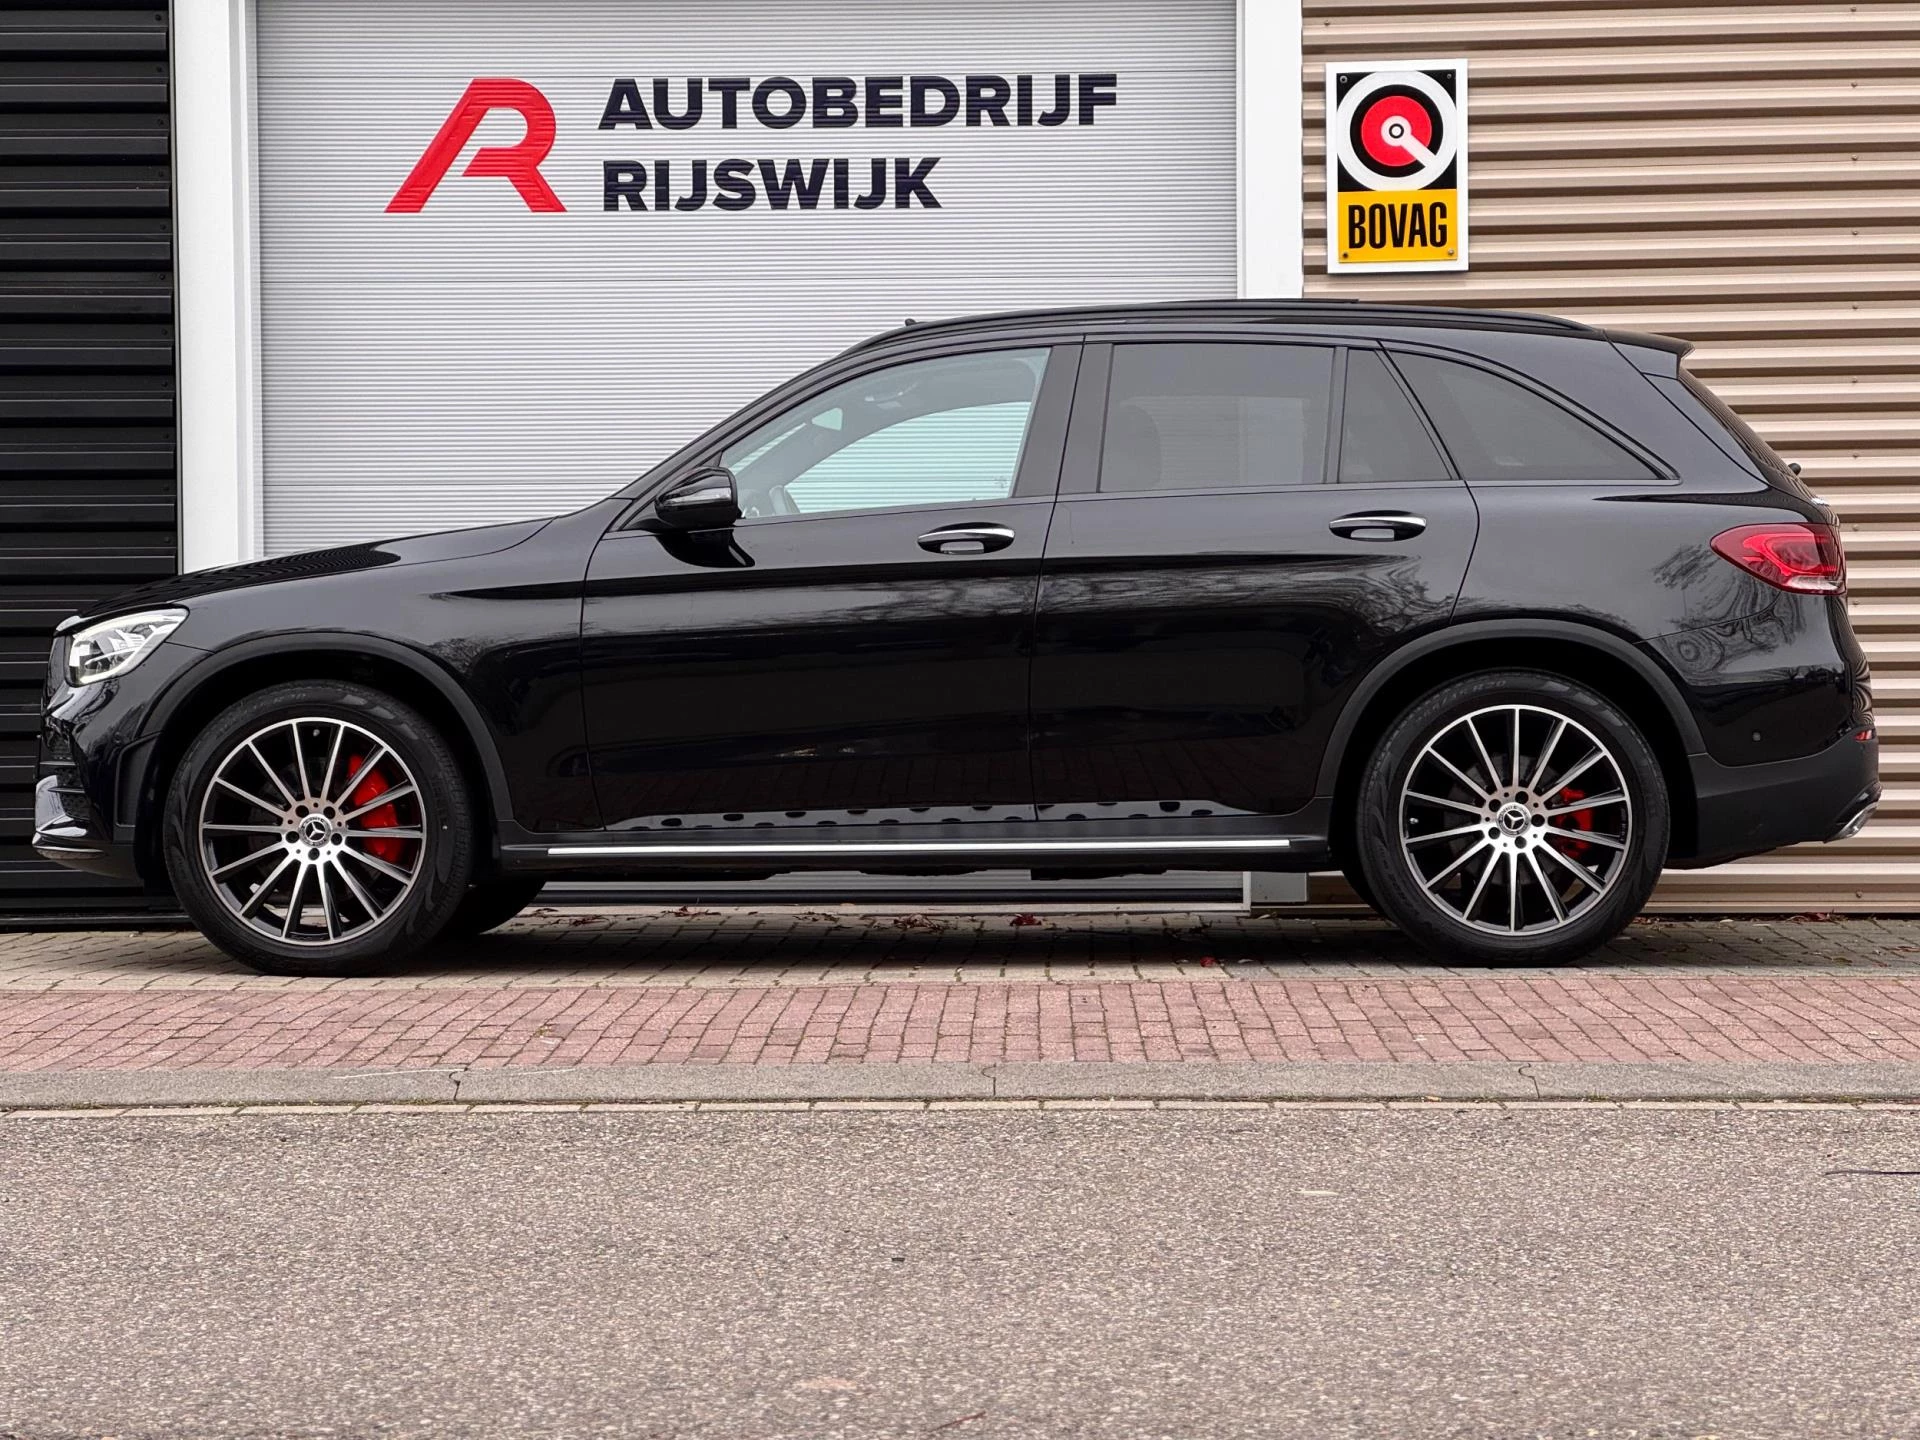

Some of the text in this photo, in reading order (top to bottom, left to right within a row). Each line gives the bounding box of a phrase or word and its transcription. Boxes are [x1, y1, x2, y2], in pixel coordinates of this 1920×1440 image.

[597, 73, 1118, 131] AUTOBEDRIJF
[603, 157, 943, 212] RIJSWIJK
[1348, 202, 1448, 249] BOVAG
